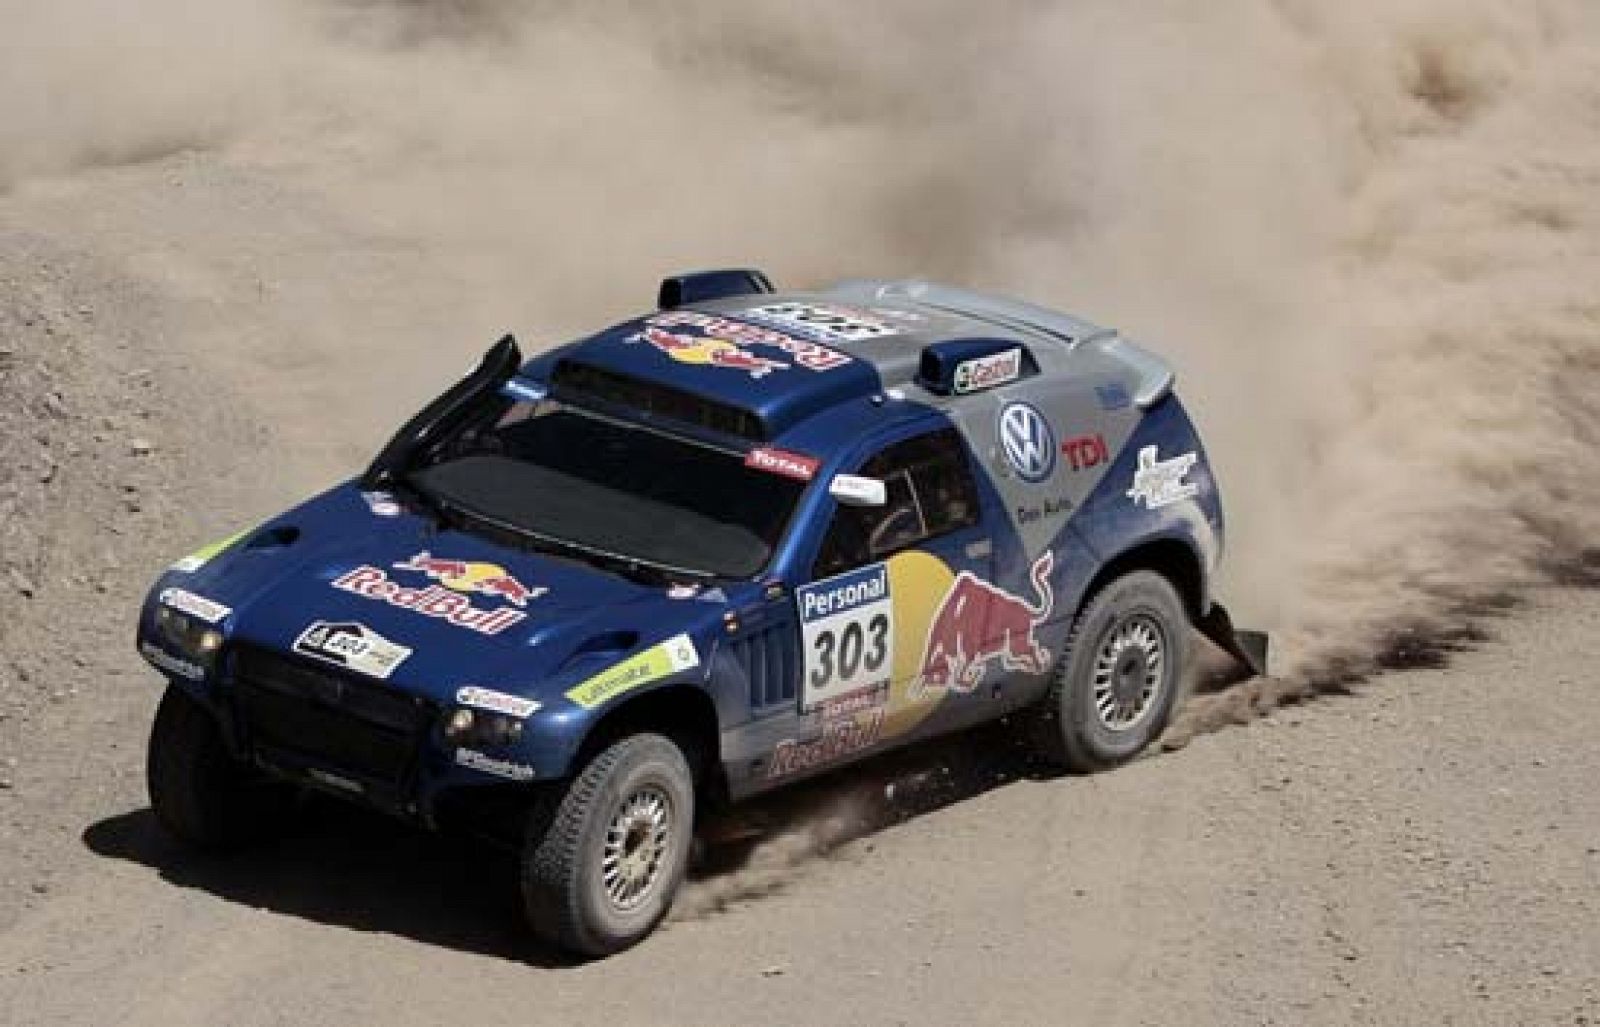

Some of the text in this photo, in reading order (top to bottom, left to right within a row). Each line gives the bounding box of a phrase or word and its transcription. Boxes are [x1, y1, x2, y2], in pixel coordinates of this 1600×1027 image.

[1061, 433, 1109, 471] TDI
[805, 570, 886, 618] Personal
[811, 613, 888, 689] 303
